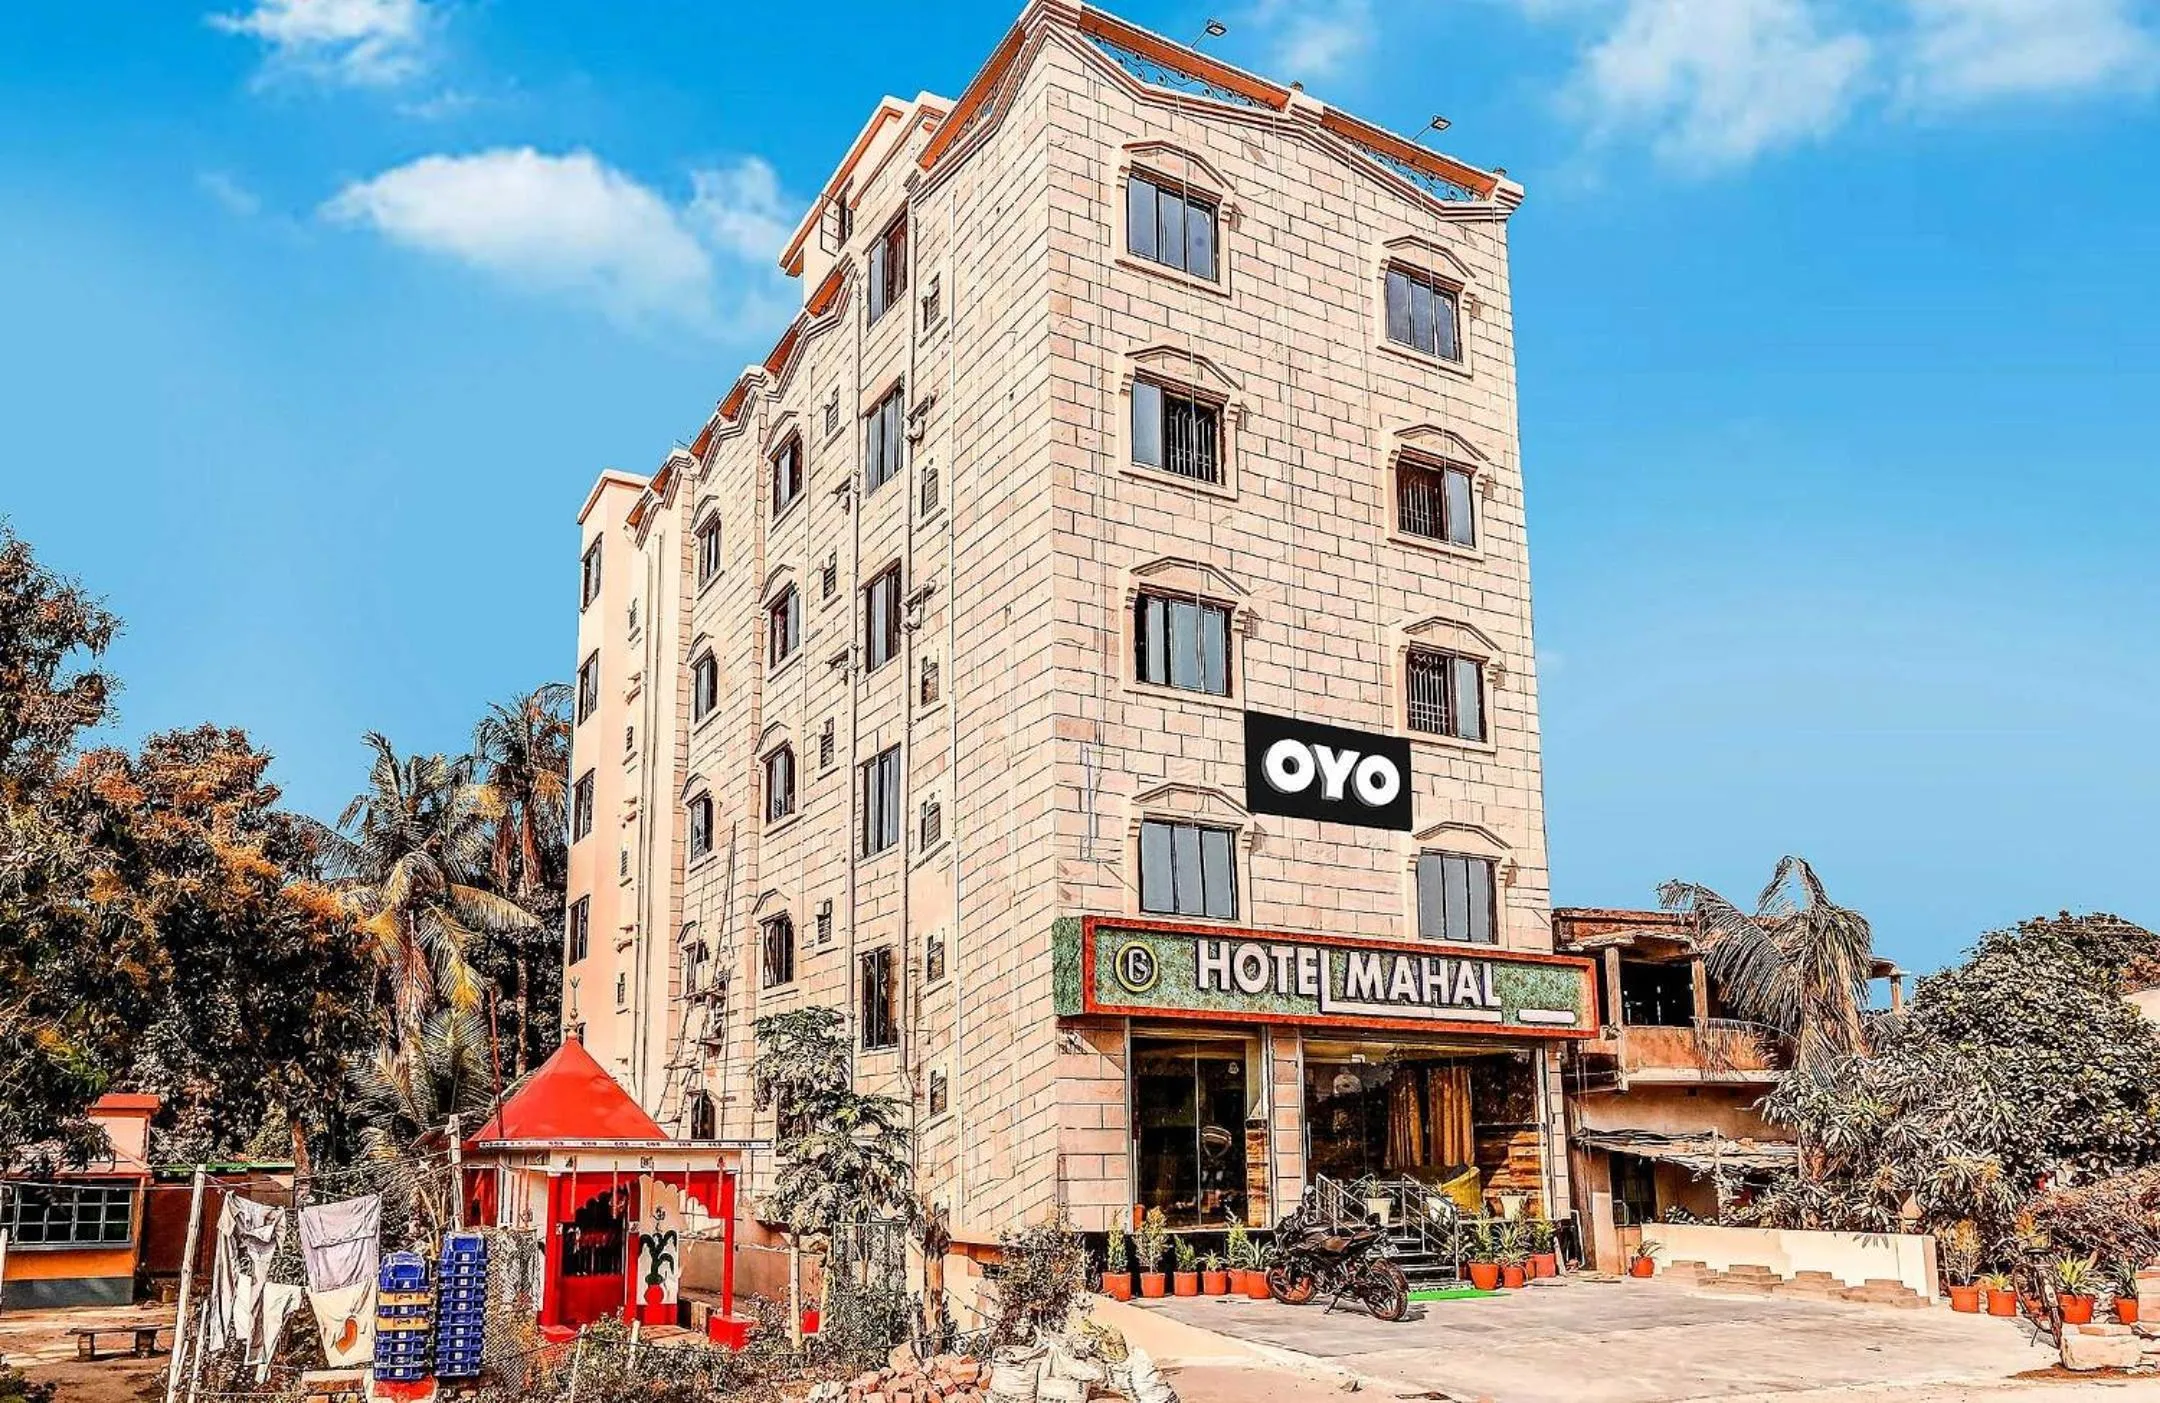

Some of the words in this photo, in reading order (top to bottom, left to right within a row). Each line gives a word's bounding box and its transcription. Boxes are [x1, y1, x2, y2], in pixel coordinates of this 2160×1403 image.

[1261, 738, 1401, 807] OYO
[1198, 938, 1331, 1012] HOTEL
[1346, 950, 1502, 1007] MAHAL
